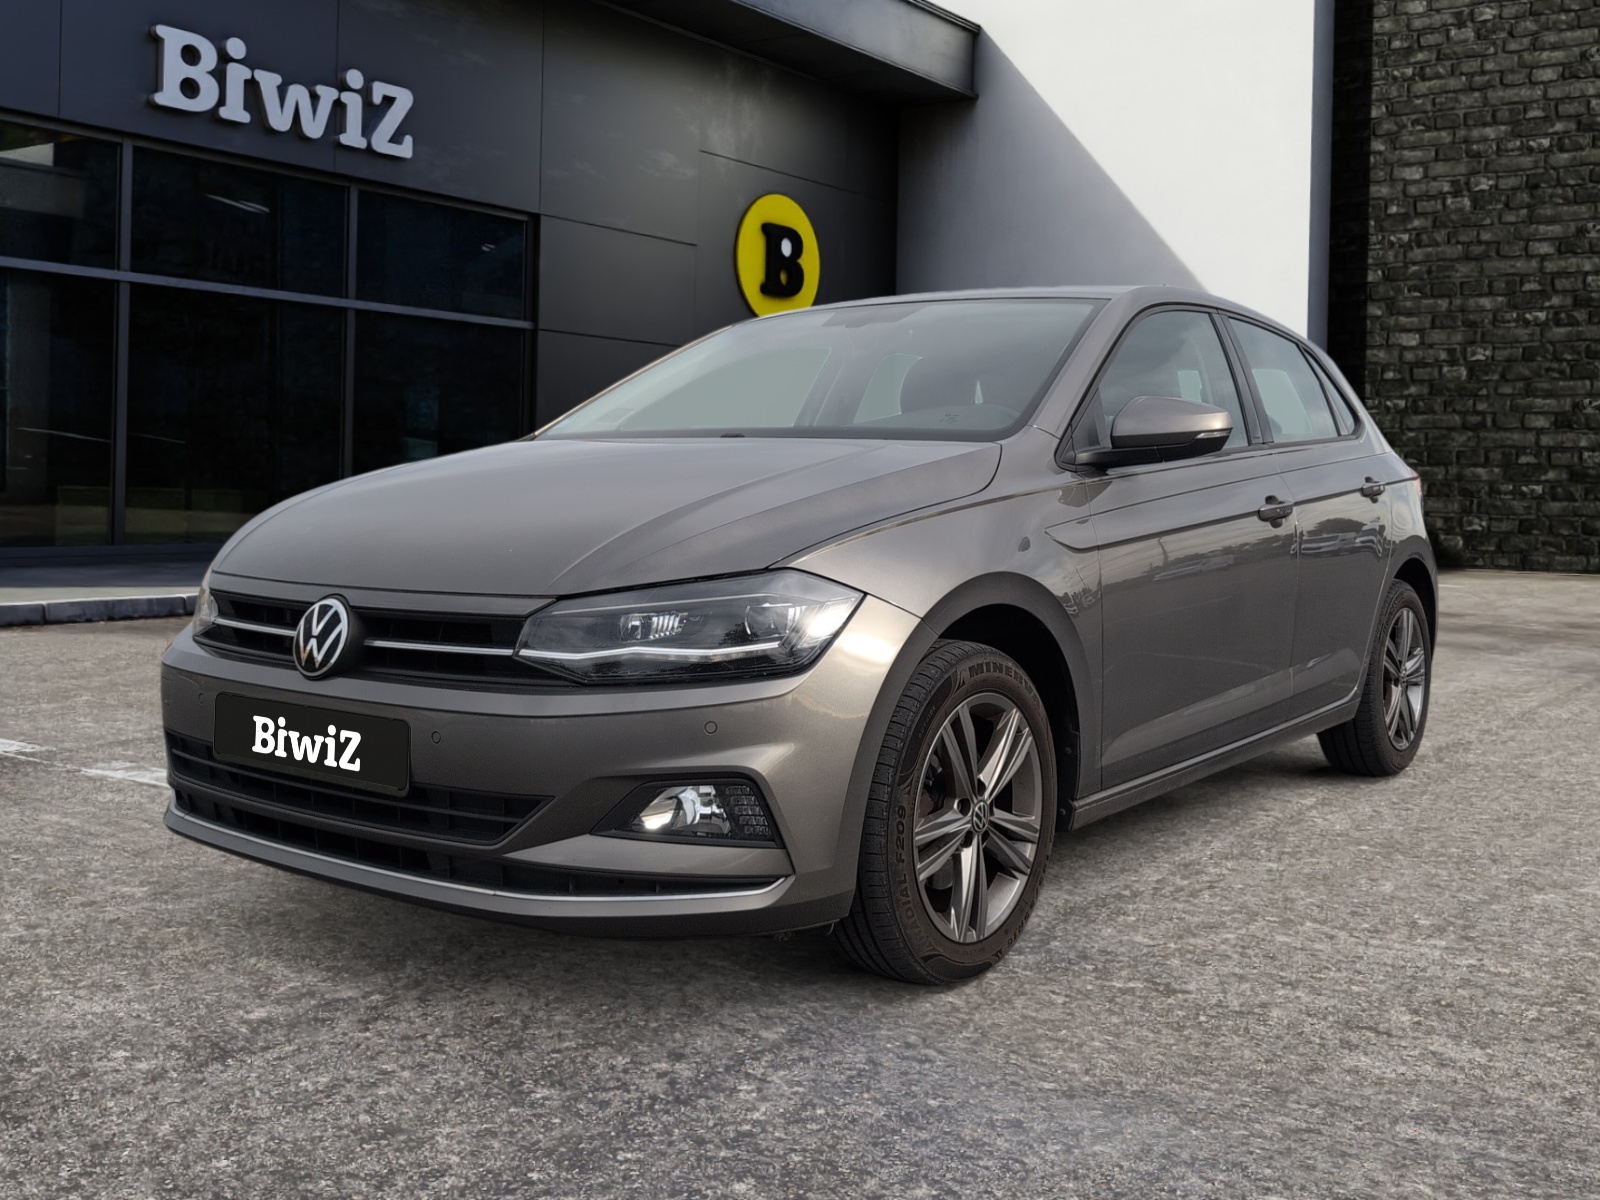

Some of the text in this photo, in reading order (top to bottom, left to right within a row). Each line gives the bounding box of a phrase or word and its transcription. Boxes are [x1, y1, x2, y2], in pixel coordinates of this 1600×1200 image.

[152, 24, 414, 159] BiwiZ
[760, 222, 805, 298] B
[251, 715, 362, 772] BiwiZ
[895, 804, 907, 864] F209
